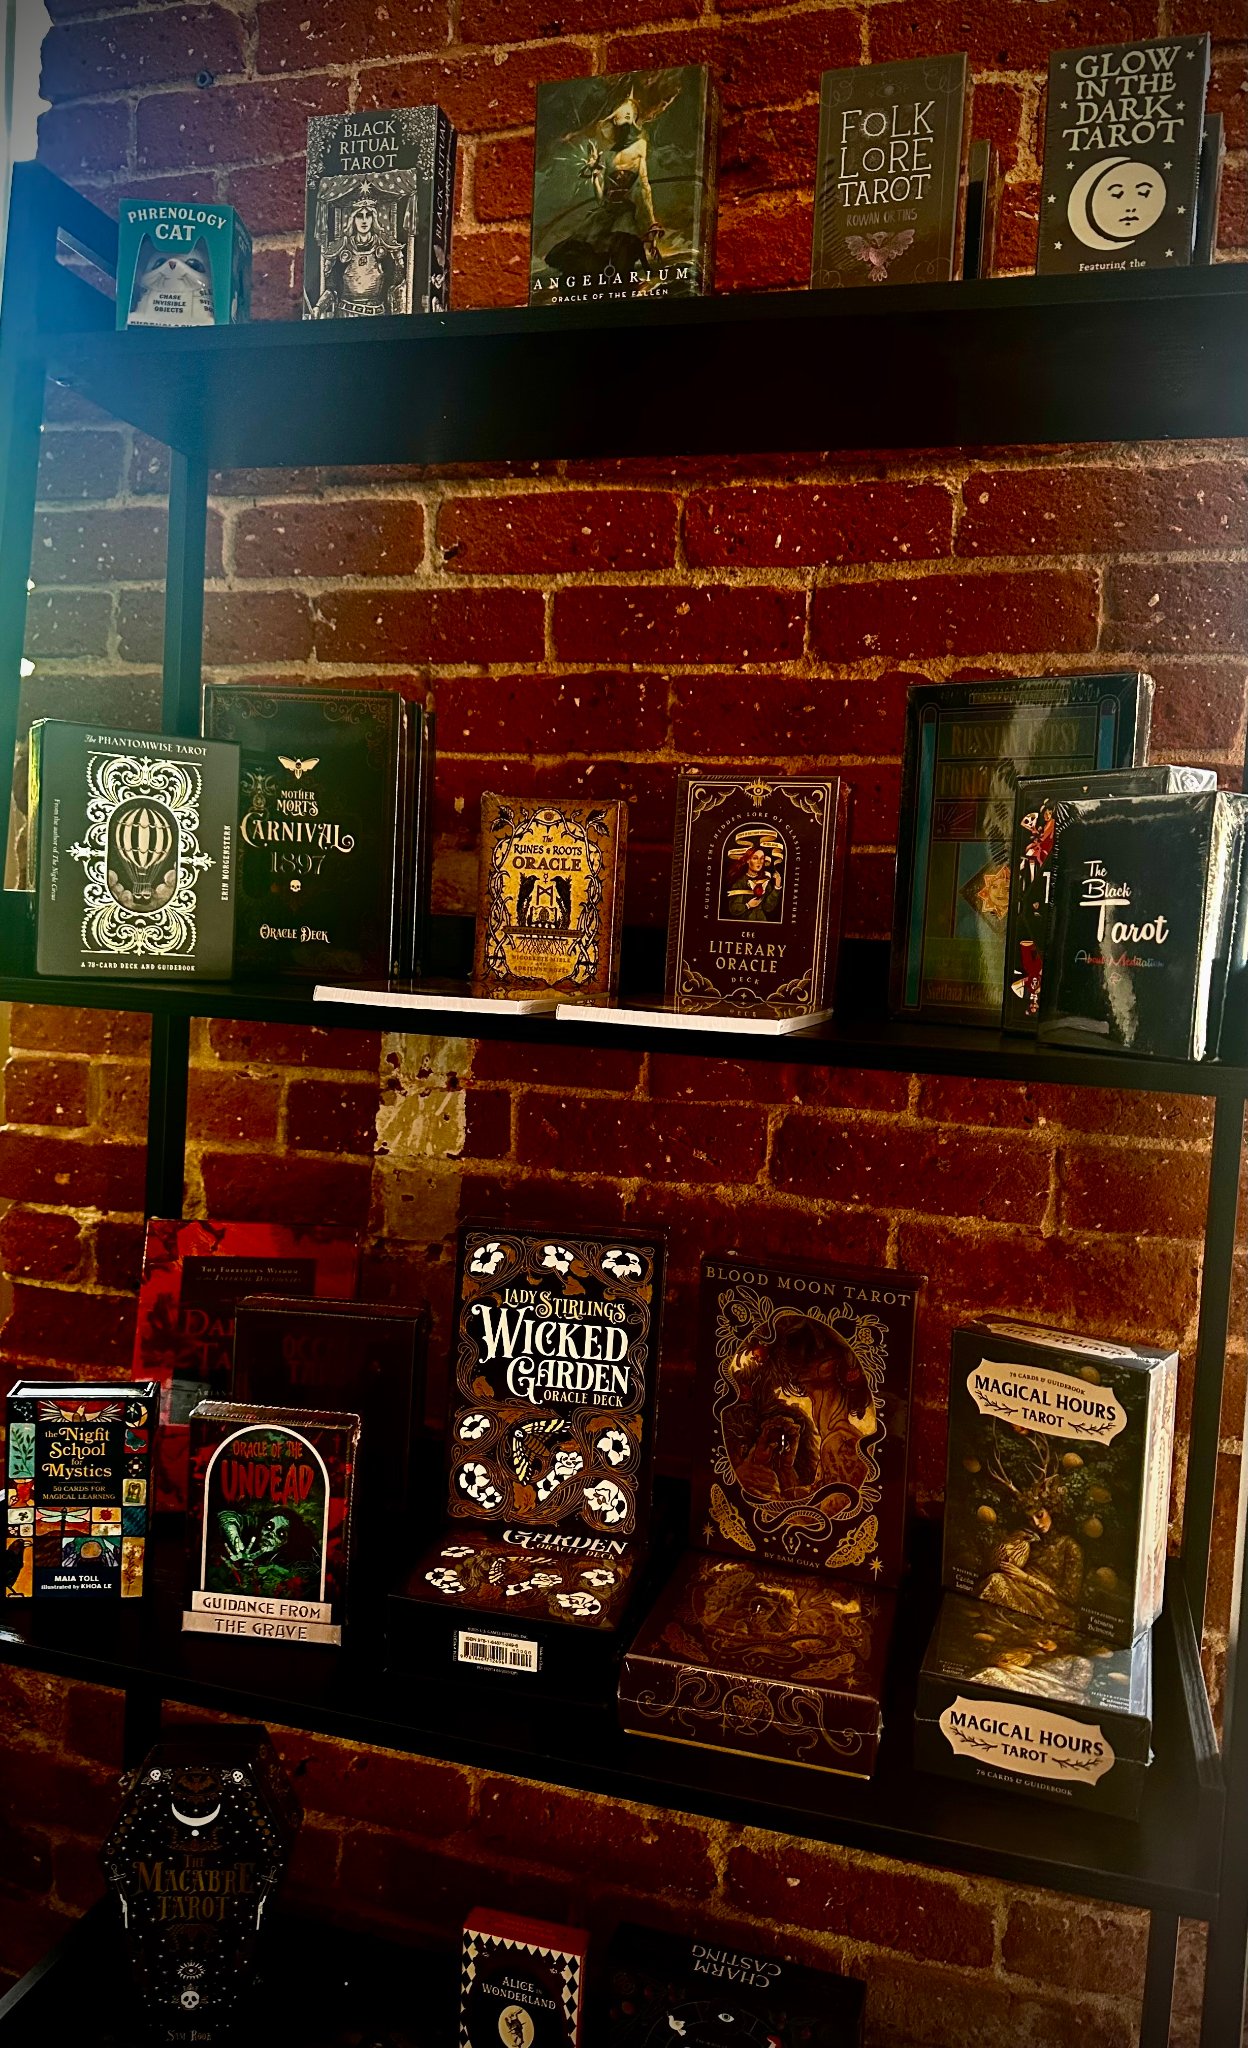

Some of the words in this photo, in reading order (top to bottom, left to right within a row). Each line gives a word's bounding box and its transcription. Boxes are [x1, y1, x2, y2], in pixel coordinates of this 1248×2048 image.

[1075, 45, 1182, 79] GLOW
[1075, 78, 1110, 100] IN
[1115, 71, 1177, 96] THE
[1075, 94, 1173, 126] DARK
[343, 120, 396, 138] BLACK
[840, 100, 936, 144] FOLK
[1062, 118, 1185, 151] TAROT
[339, 137, 399, 155] RITUAL
[341, 154, 397, 171] TAROT
[838, 137, 934, 179] LORE
[837, 173, 931, 207] TAROT
[127, 207, 227, 230] PHRENOLOGY
[846, 211, 880, 227] ROWAN
[155, 224, 196, 241] CAT
[1079, 260, 1127, 272] Featuring
[1129, 258, 1147, 268] the
[533, 267, 689, 290] ANGELARIUM
[152, 299, 187, 307] INVISIBLE
[551, 294, 588, 303] ORACLE
[631, 288, 669, 298] FALLEN
[98, 735, 173, 753] PHANTOMWISE
[175, 744, 208, 756] TAROT
[280, 788, 315, 801] MOTHER
[239, 811, 355, 854] CARNIVAL
[513, 843, 544, 855] RUNES
[552, 845, 583, 856] ROOTS
[270, 851, 328, 875] 1897
[512, 856, 582, 872] ORACLE
[1083, 859, 1108, 877] The
[221, 880, 229, 901] ERIN
[1081, 878, 1132, 898] Black
[1079, 898, 1170, 944] Tarot
[259, 923, 298, 941] ORACLE
[300, 925, 332, 944] DECK
[708, 940, 787, 958] LITERARY
[120, 962, 139, 970] DECK
[157, 963, 196, 972] GUIDEBOOK
[715, 956, 778, 974] ORACLE
[731, 976, 760, 985] DECK
[705, 1265, 769, 1286] BLOOD
[776, 1276, 837, 1296] MOON
[843, 1286, 911, 1307] TAROT
[502, 1288, 537, 1308] LADY
[535, 1290, 626, 1325] STIRLING'S
[471, 1303, 629, 1363] WICKED
[506, 1355, 631, 1405] GARDEN
[1017, 1373, 1039, 1382] CARDS
[1047, 1379, 1086, 1396] GUIDEBOOK
[543, 1389, 588, 1404] ORACLE
[593, 1394, 624, 1408] DECK
[974, 1374, 1052, 1407] MAGICAL
[1056, 1394, 1116, 1422] HOURS
[1021, 1407, 1065, 1427] TAROT
[45, 1430, 58, 1438] the
[58, 1427, 110, 1444] Night
[49, 1441, 106, 1459] School
[232, 1439, 268, 1459] ORACLE
[285, 1440, 303, 1459] THE
[41, 1463, 112, 1480] Mystics
[71, 1457, 83, 1465] for
[220, 1459, 315, 1505] UNDEAD
[502, 1529, 629, 1555] GARDEN
[202, 1597, 275, 1615] GUIDANCE
[279, 1604, 321, 1619] FROM
[214, 1618, 247, 1634] THE
[252, 1622, 308, 1640] GRAVE
[950, 1710, 1034, 1743] MAGICAL
[1039, 1730, 1104, 1756] HOURS
[1001, 1743, 1049, 1763] TAROT
[987, 1770, 1014, 1783] CARDS
[1024, 1780, 1073, 1796] GUIDEBOOK
[129, 1860, 257, 1896] MACABRE
[157, 1895, 230, 1922] TAROT
[691, 1944, 782, 1977] CASTING
[693, 1959, 770, 1988] CHARM
[502, 1976, 535, 1993] ALICE
[481, 1982, 556, 2010] WONDERLAND
